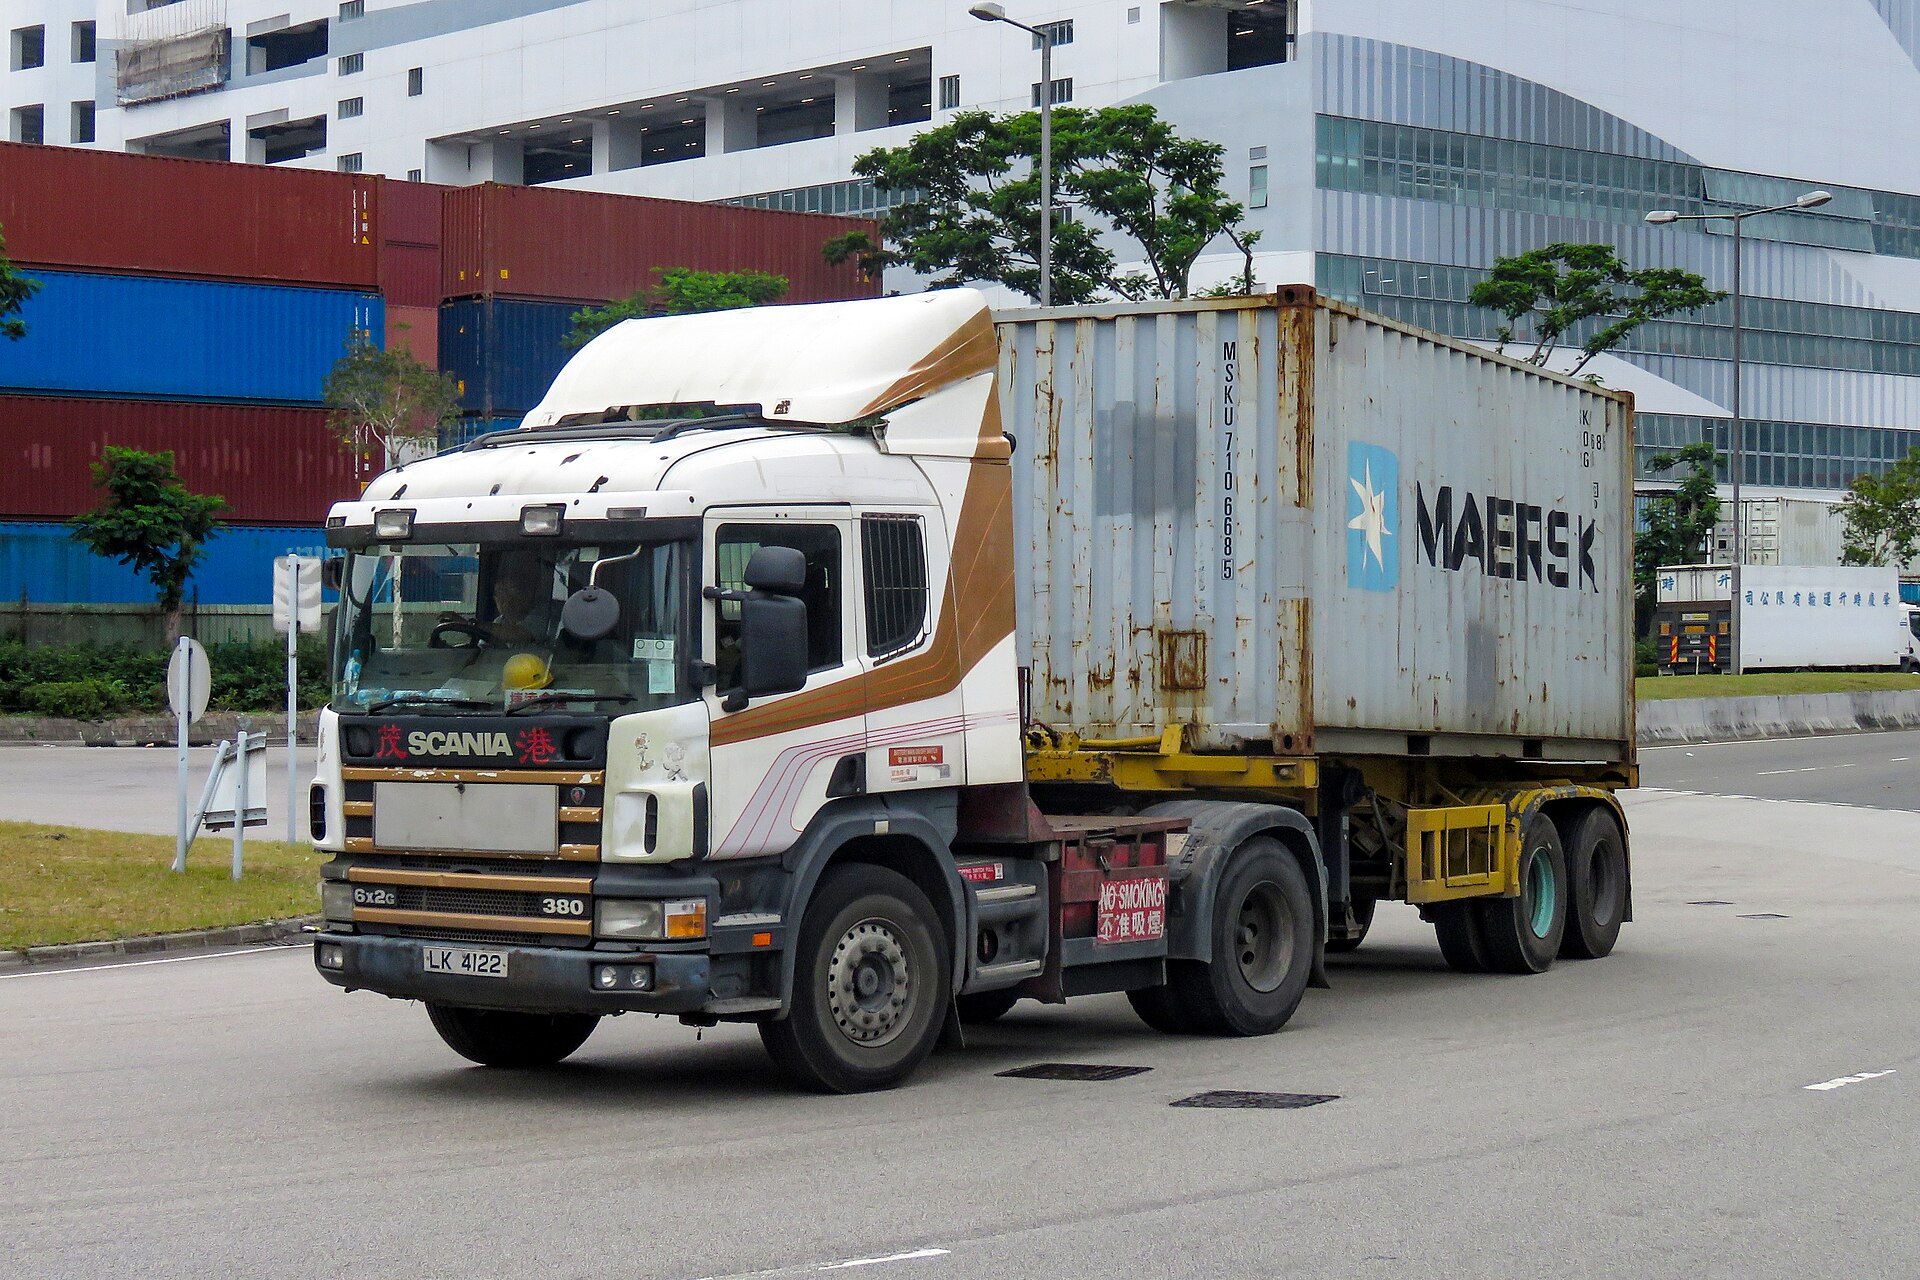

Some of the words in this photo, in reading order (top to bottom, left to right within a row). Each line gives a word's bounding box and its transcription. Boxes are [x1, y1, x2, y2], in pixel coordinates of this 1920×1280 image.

[1416, 480, 1599, 594] MAERSK
[376, 724, 407, 759] 茂
[408, 731, 514, 757] SCANIA
[515, 727, 556, 765] 港
[542, 898, 584, 915] 380
[1100, 883, 1116, 911] NO
[1118, 881, 1162, 910] SMOKING
[1100, 911, 1161, 938] 不准吸煙
[428, 950, 452, 970] LK
[461, 953, 502, 974] 4122
